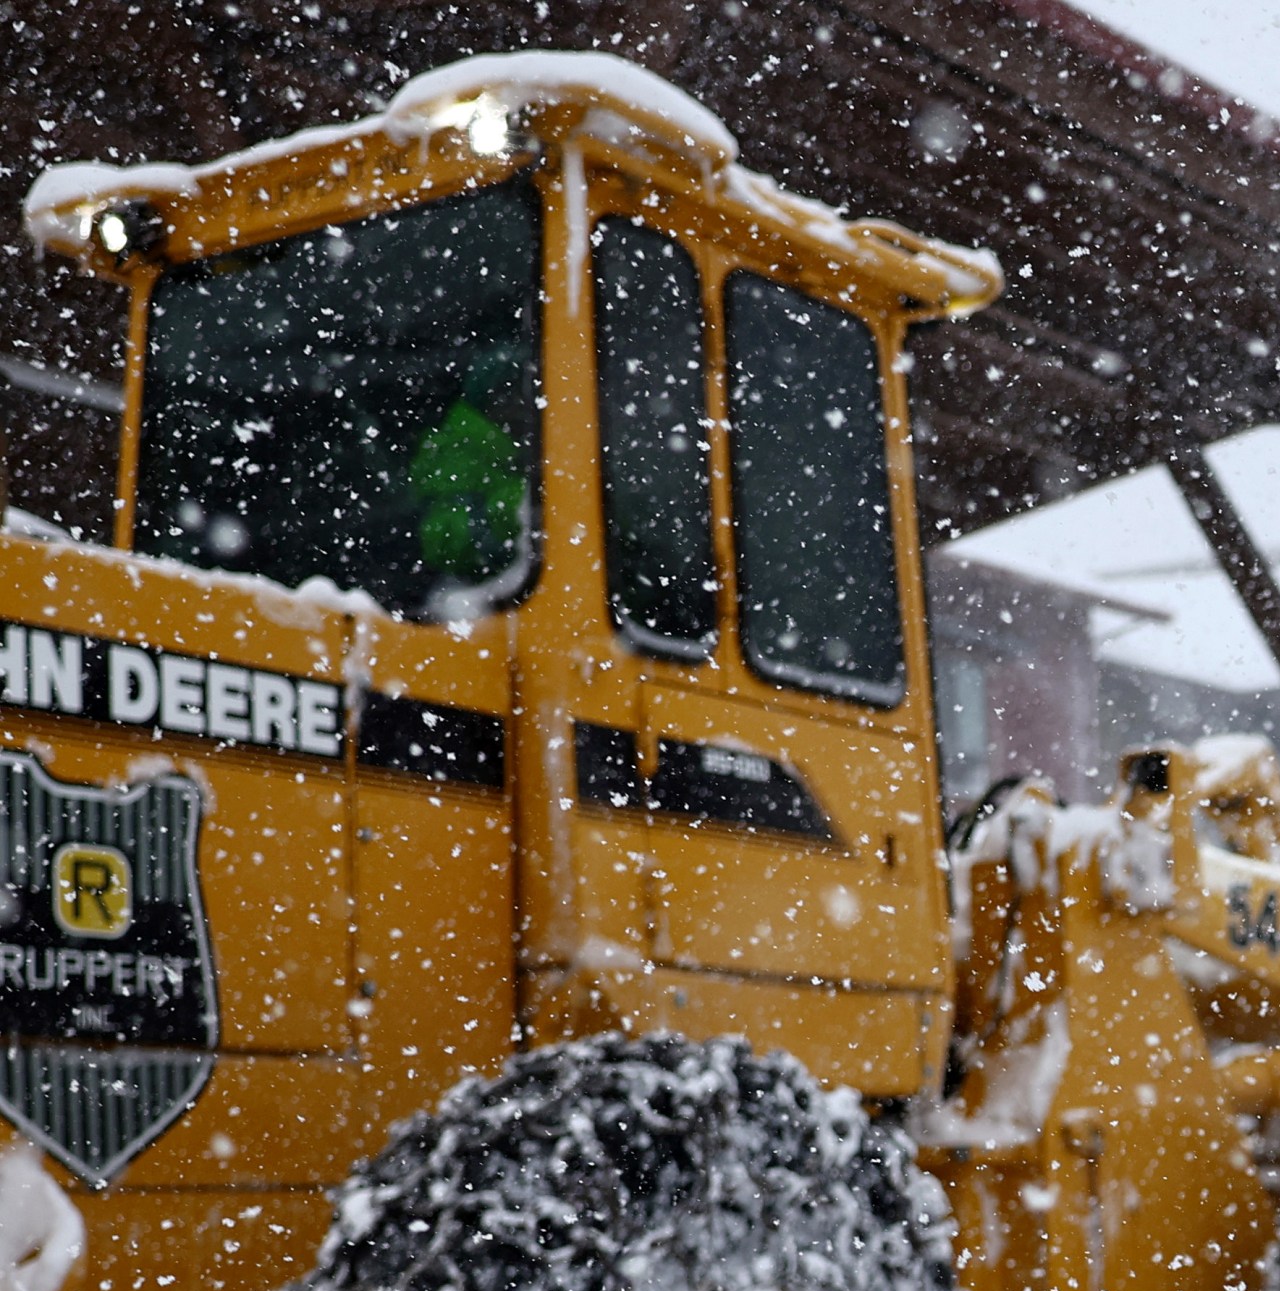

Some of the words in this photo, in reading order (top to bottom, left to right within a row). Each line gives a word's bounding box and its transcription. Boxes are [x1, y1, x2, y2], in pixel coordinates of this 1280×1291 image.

[108, 646, 341, 756] DEERE
[71, 858, 113, 922] R
[0, 943, 190, 1000] RUPPERT
